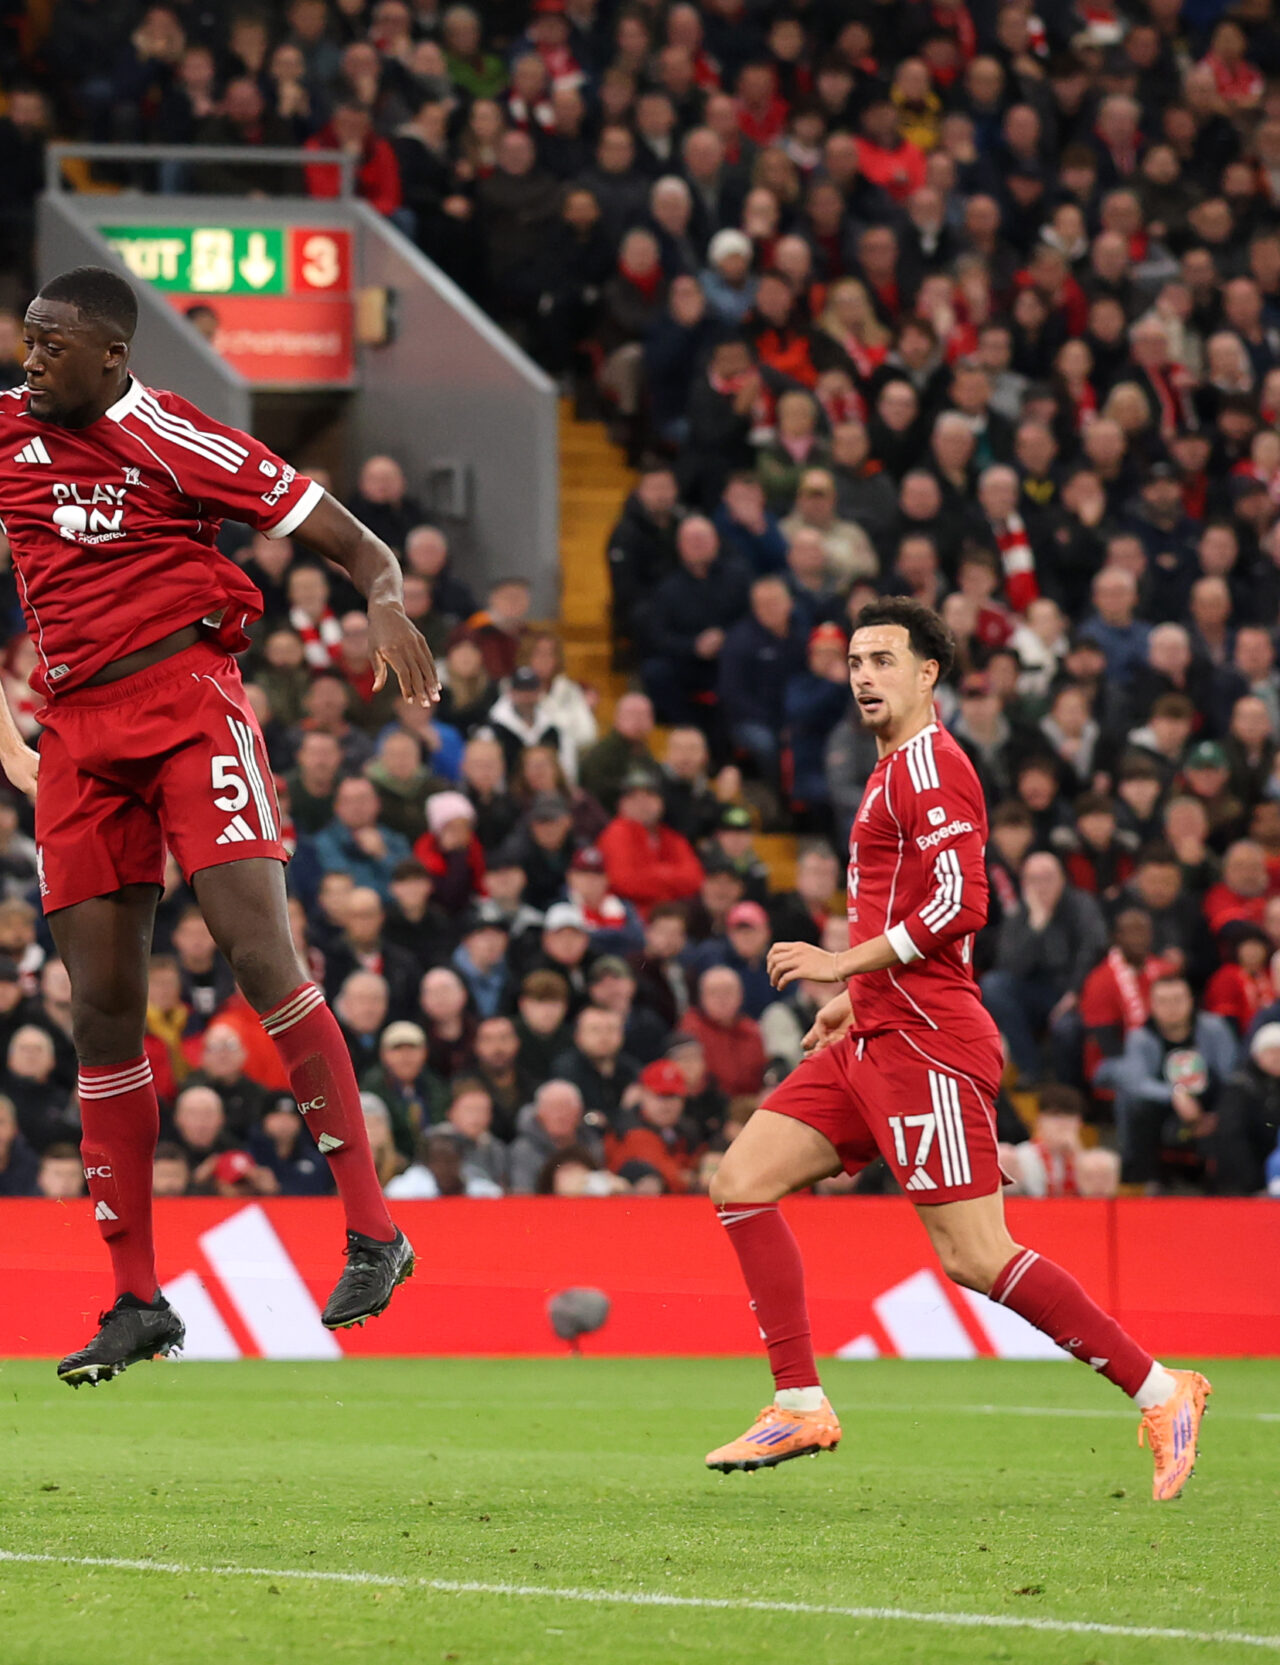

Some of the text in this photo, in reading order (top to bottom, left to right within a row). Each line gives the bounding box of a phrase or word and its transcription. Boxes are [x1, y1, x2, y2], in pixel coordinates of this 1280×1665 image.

[109, 237, 186, 281] XIT
[302, 235, 340, 288] 3
[52, 483, 127, 506] PLAY
[211, 755, 249, 812] 5
[915, 820, 973, 851] Expedia
[888, 1112, 936, 1166] 17
